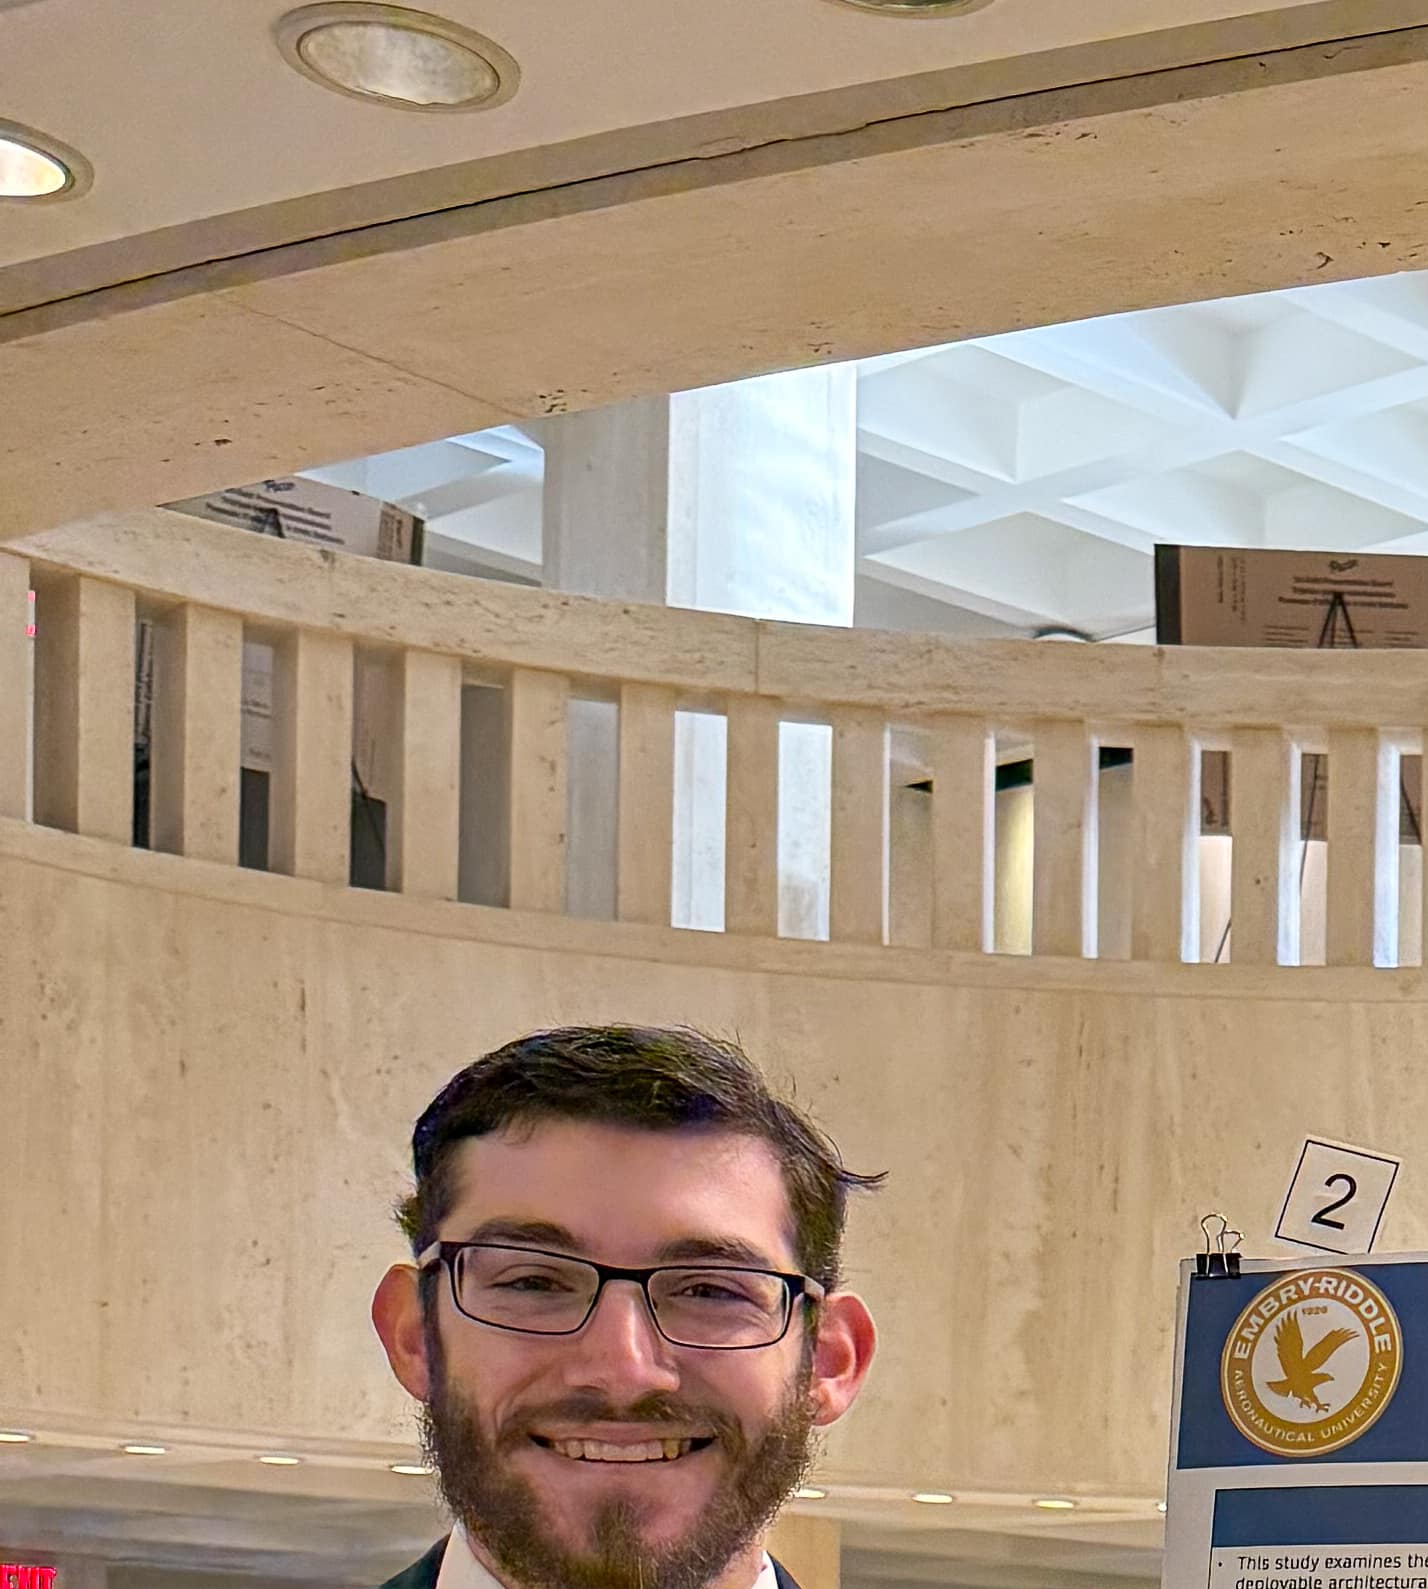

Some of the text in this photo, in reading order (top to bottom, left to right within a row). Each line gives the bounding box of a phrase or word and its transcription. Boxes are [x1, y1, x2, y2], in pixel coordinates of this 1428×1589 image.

[1310, 1172, 1357, 1231] 2
[1234, 1276, 1392, 1360] EMBRY-RIDDLE
[1233, 1362, 1388, 1443] AERONAUTICAL UNIVERSITY
[1237, 1555, 1270, 1571] This
[1274, 1554, 1320, 1573] study
[1324, 1553, 1402, 1569] examines
